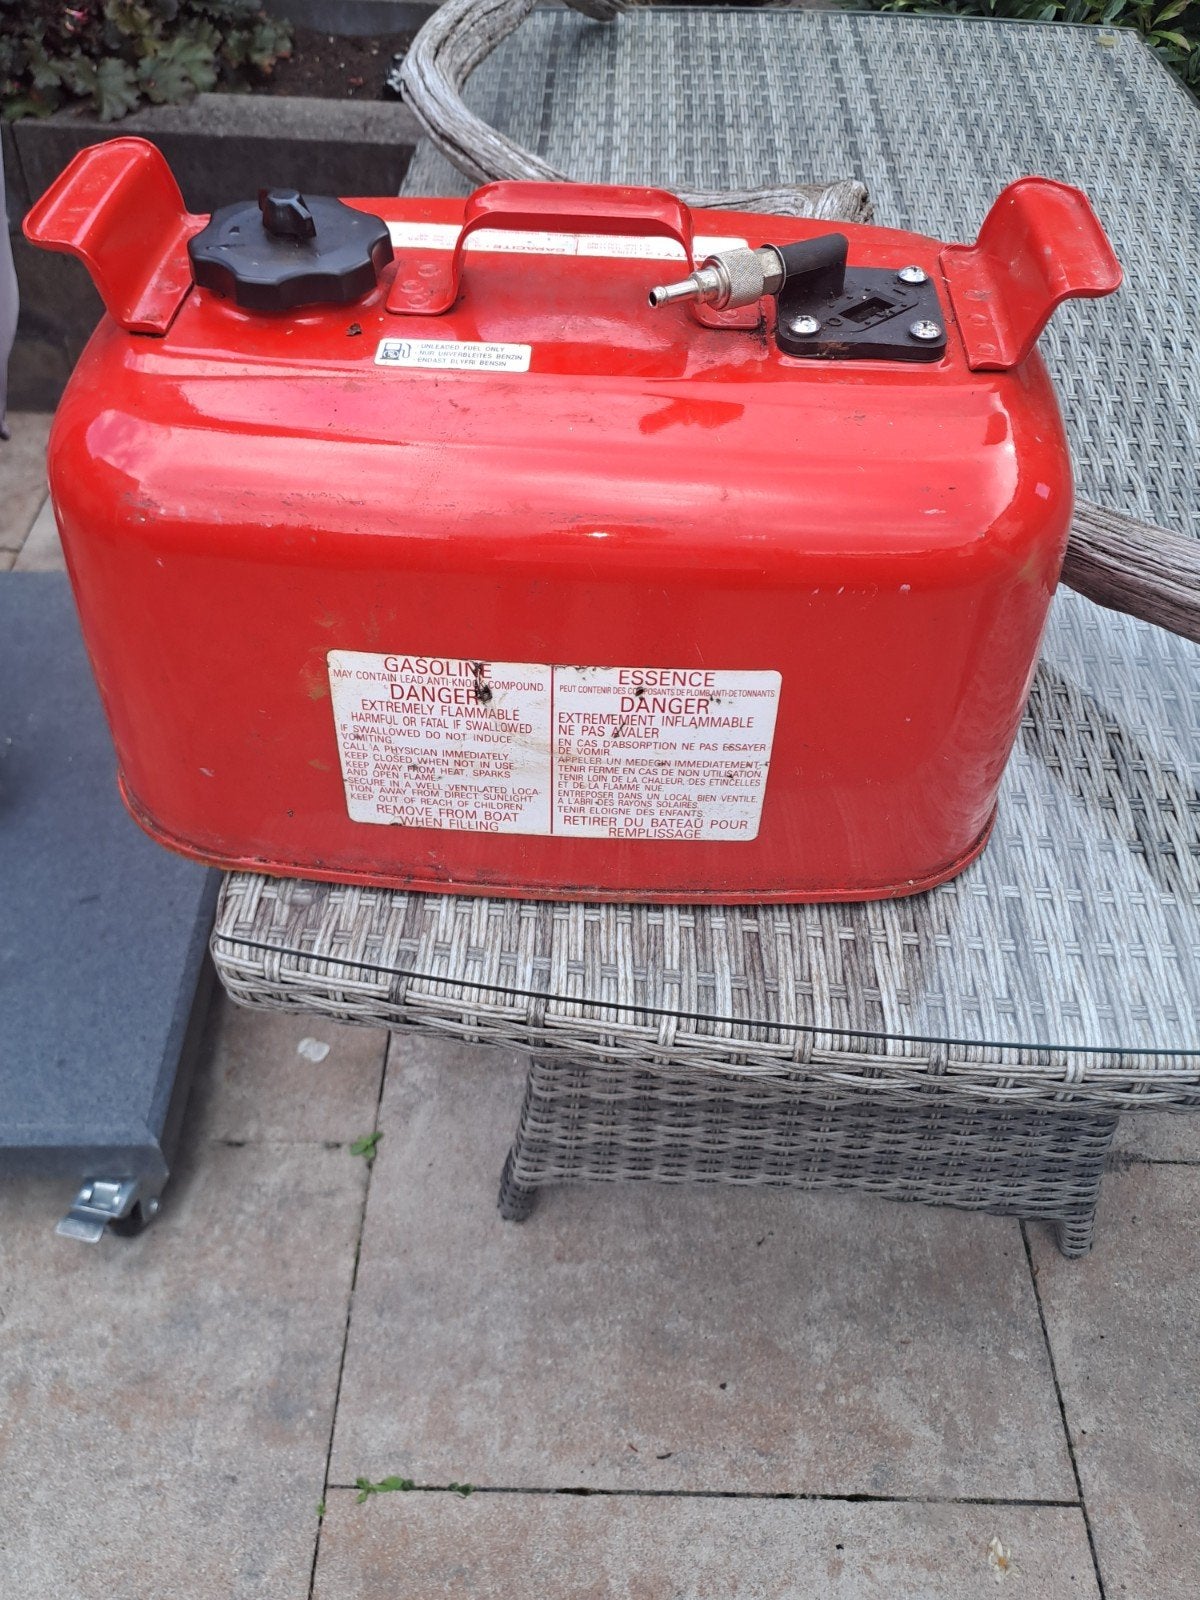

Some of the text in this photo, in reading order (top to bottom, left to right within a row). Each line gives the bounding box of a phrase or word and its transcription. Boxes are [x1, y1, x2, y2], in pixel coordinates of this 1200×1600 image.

[384, 657, 492, 679] GASOLINE
[333, 669, 352, 679] MAY
[356, 671, 396, 682] CONTAIN
[400, 675, 423, 684] LEAD
[618, 670, 716, 687] ESSENCE
[391, 684, 479, 705] DANGER
[578, 686, 611, 694] CONTENIR
[628, 687, 674, 696] COPOSANTS
[686, 689, 709, 697] PLOMB
[361, 699, 520, 721] EXTREMELY FLAMMABLE
[621, 696, 709, 714] DANGER
[351, 712, 532, 733] HARMFUL OR FATAL IF SWALLOWED
[558, 712, 754, 728] EXTREMEMENT INFLAMMABLE
[341, 732, 395, 744] VOMITING.
[353, 725, 420, 737] SWALLOWED
[426, 731, 440, 739] DO
[446, 732, 467, 741] NOT
[473, 734, 512, 743] INDUCE
[558, 724, 660, 738] NE PAS AVALER
[343, 742, 367, 751] CALL
[384, 745, 437, 756] PHYSICIAN
[442, 750, 509, 760] IMMEDIATELY
[558, 738, 571, 746] EN
[577, 739, 598, 747] CAS
[603, 740, 677, 750] D'ABSORPTION
[700, 743, 718, 751] PAS
[723, 743, 766, 751] ESSAYER
[576, 748, 610, 756] VOMIR
[344, 751, 368, 759] KEEP
[373, 754, 412, 763] CLOSED
[417, 757, 448, 766] WHEN
[480, 761, 490, 769] IN
[495, 762, 515, 770] USE
[558, 756, 601, 765] APPELER
[606, 757, 621, 765] UN
[346, 760, 369, 768] KEEP
[374, 762, 402, 771] AWAY
[408, 765, 435, 773] FROM
[472, 770, 511, 778] SPARKS
[373, 770, 399, 779] OPEN
[588, 766, 620, 774] FERME
[678, 769, 700, 777] NON
[347, 777, 386, 786] SECURE
[390, 779, 399, 787] IN
[416, 782, 443, 790] WELL
[448, 784, 507, 794] VENTILATED
[512, 787, 541, 795] LOCA-
[380, 787, 406, 795] AWAY
[412, 789, 439, 797] FROM
[445, 791, 478, 799] DIRECT
[603, 783, 640, 791] FLAMME
[351, 793, 373, 801] KEEP
[378, 795, 398, 803] OUT
[420, 798, 452, 807] REACH
[474, 801, 525, 811] CHILDREN.
[557, 790, 614, 798] ENTREPOSER
[697, 794, 716, 802] BIEN
[618, 799, 652, 808] RAYONS
[376, 804, 519, 822] REMOVE FROM BOAT
[589, 807, 631, 815] ELOIGNE
[636, 808, 654, 816] DES
[400, 816, 499, 831] WHEN FILLING
[563, 815, 748, 829] RETIRER DU BATEAU POUR
[608, 827, 701, 838] REMPLISSAGE
